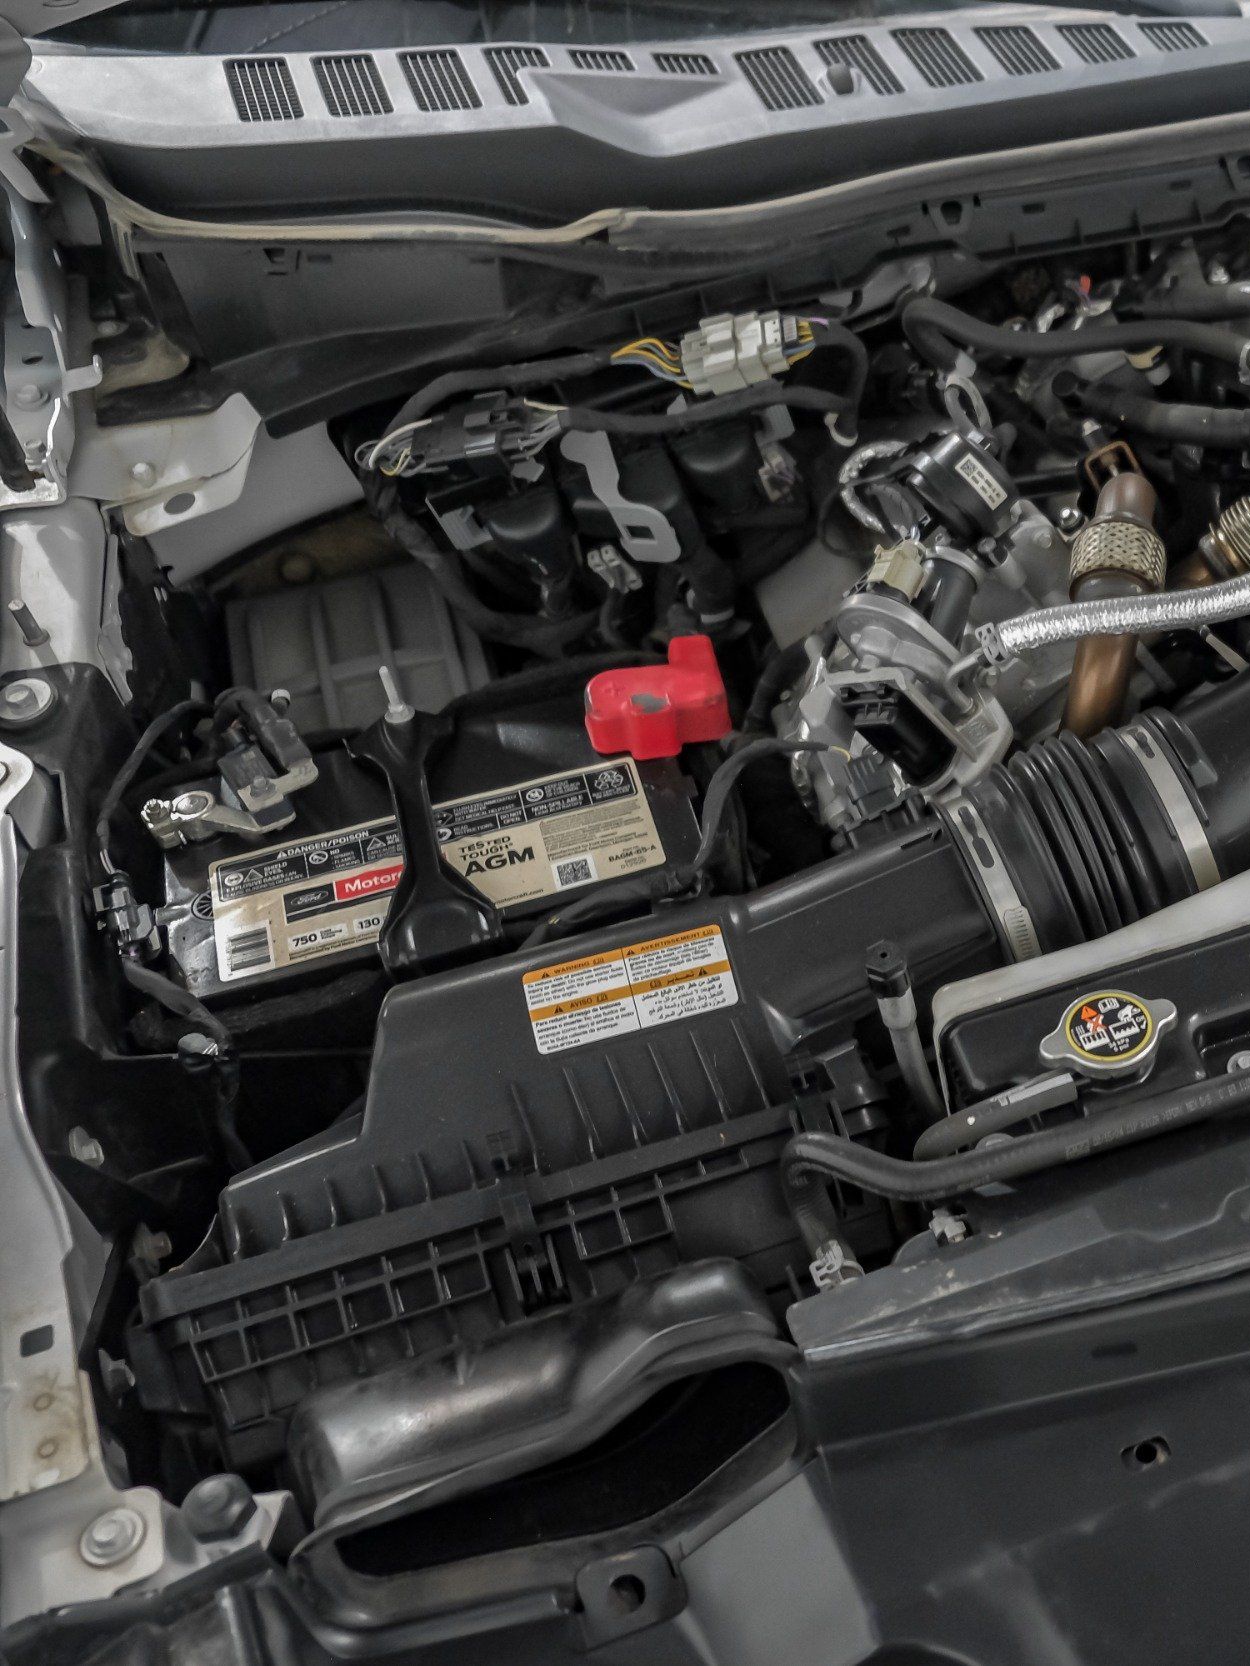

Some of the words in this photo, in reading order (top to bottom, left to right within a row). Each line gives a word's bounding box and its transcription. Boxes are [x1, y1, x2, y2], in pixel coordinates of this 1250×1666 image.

[287, 829, 369, 856] DANGER/POISON
[457, 834, 511, 854] TESTED
[462, 845, 535, 877] AGM
[358, 916, 380, 929] 130
[291, 932, 317, 947] 750
[639, 932, 700, 951] AVERTISSEMENT
[554, 961, 589, 974] WARNING
[569, 998, 592, 1008] AVISO
